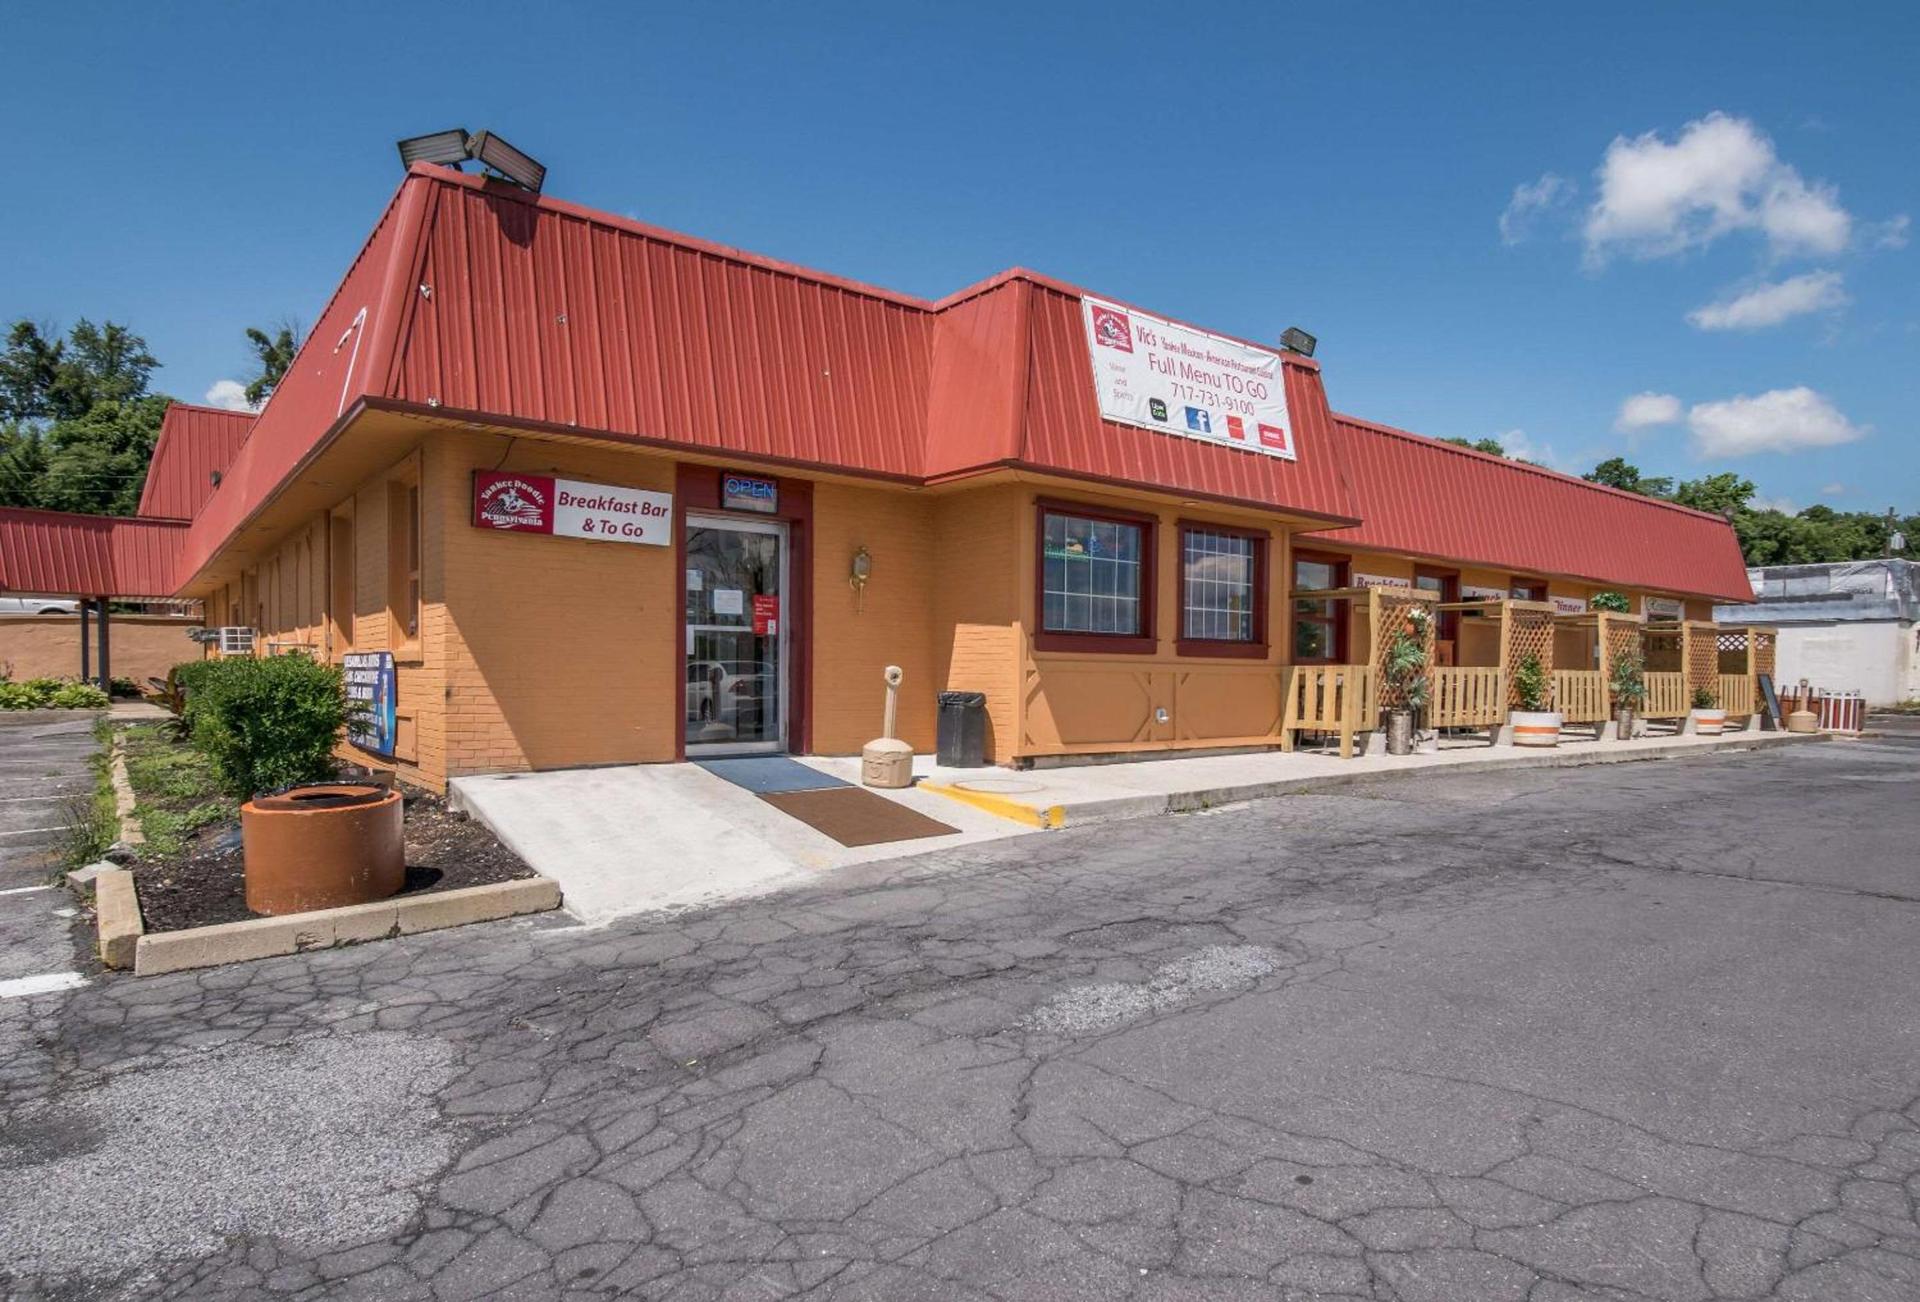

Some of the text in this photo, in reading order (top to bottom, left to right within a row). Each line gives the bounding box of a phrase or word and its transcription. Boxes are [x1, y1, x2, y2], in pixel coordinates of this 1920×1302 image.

[1136, 324, 1157, 347] Vic's
[1148, 352, 1176, 376] Full
[1180, 360, 1221, 389] Menu
[1222, 373, 1244, 393] TO
[1246, 379, 1268, 400] GO
[1171, 382, 1255, 416] 717-731-9100
[481, 480, 545, 505] Yankee Doodle
[727, 478, 775, 498] OPEN
[558, 491, 668, 518] Breakfast Bar
[481, 511, 543, 526] Pennsylvania
[582, 518, 643, 538] & To Go
